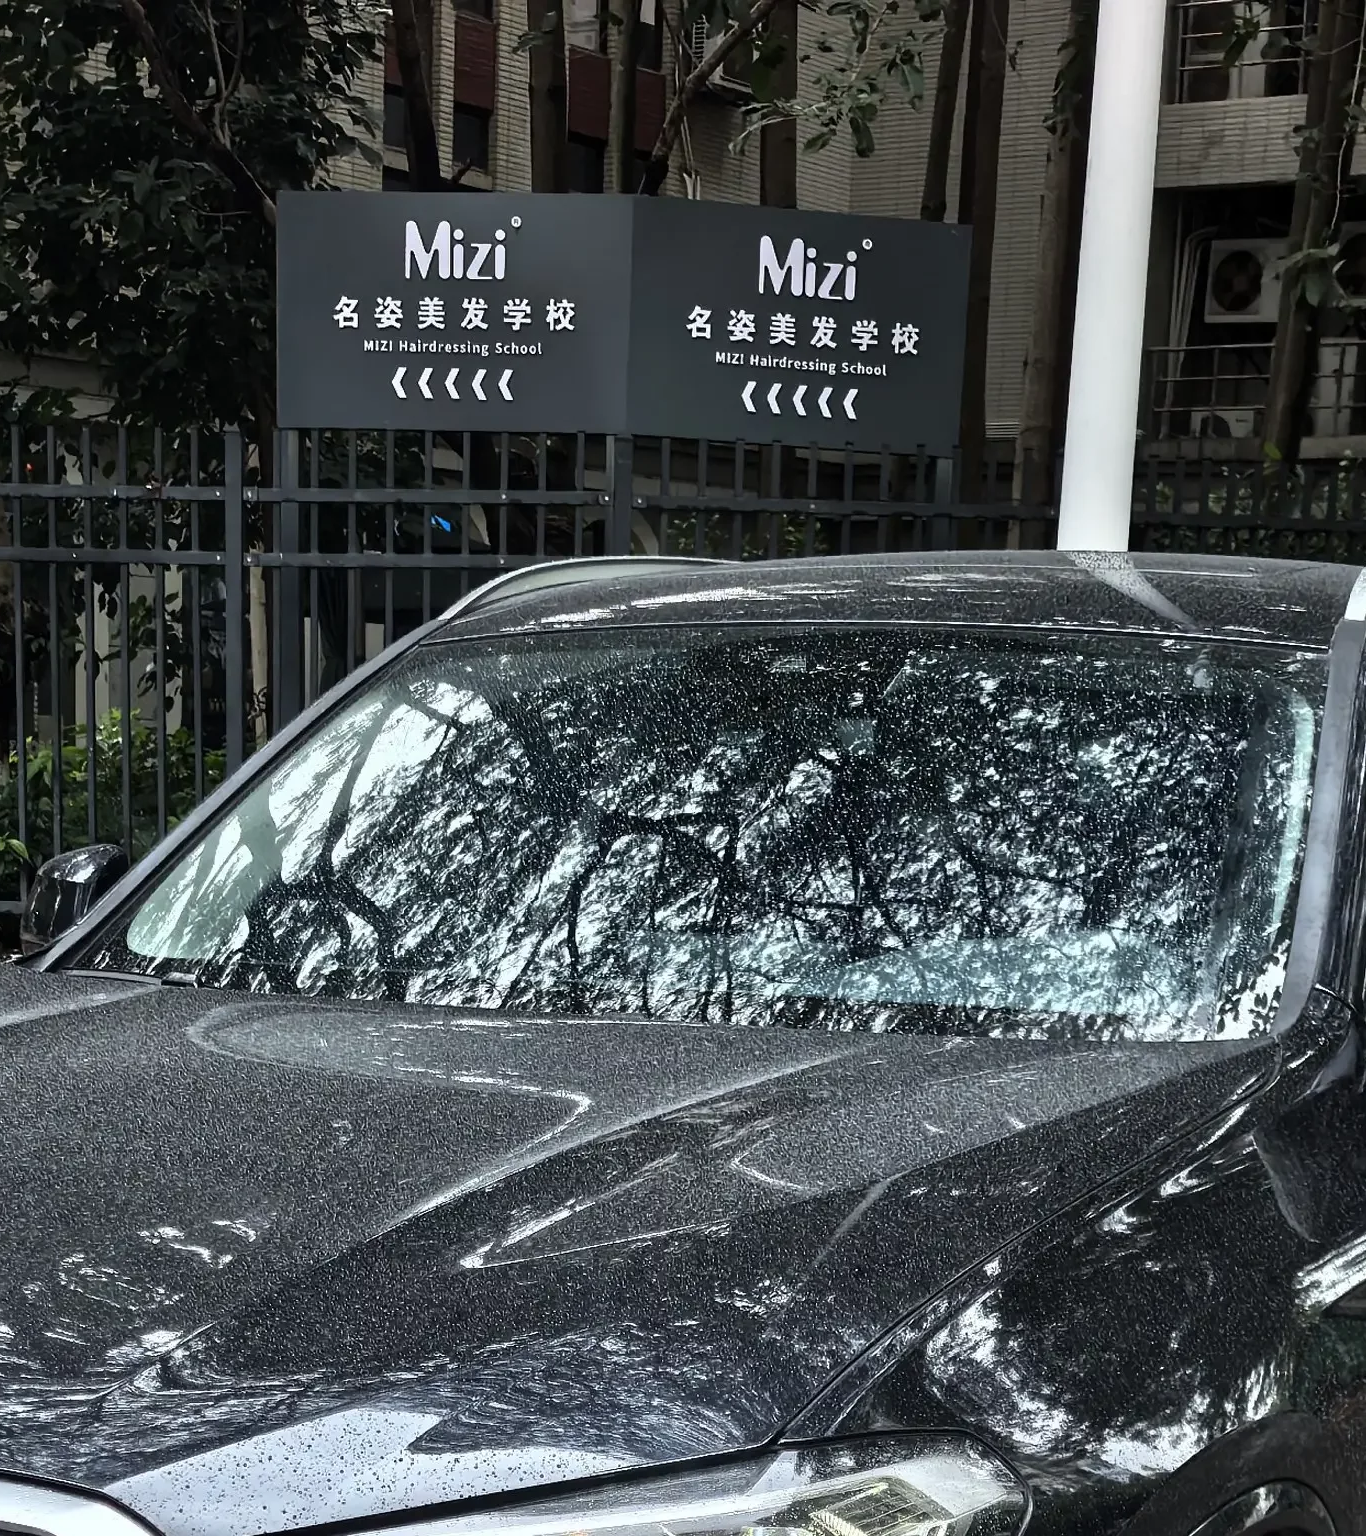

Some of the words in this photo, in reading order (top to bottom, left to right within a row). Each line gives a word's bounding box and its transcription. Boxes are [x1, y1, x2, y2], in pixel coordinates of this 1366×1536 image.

[405, 219, 506, 280] Mizi
[758, 234, 857, 301] Mizi
[333, 296, 576, 332] 名姿美发学校
[686, 305, 920, 356] 名姿美发学校
[363, 340, 393, 352] MIZI
[399, 340, 490, 356] Hairdressing
[495, 342, 542, 355] School
[715, 351, 745, 366] MIZI
[749, 354, 836, 376] Hairdressing
[841, 362, 887, 377] School
